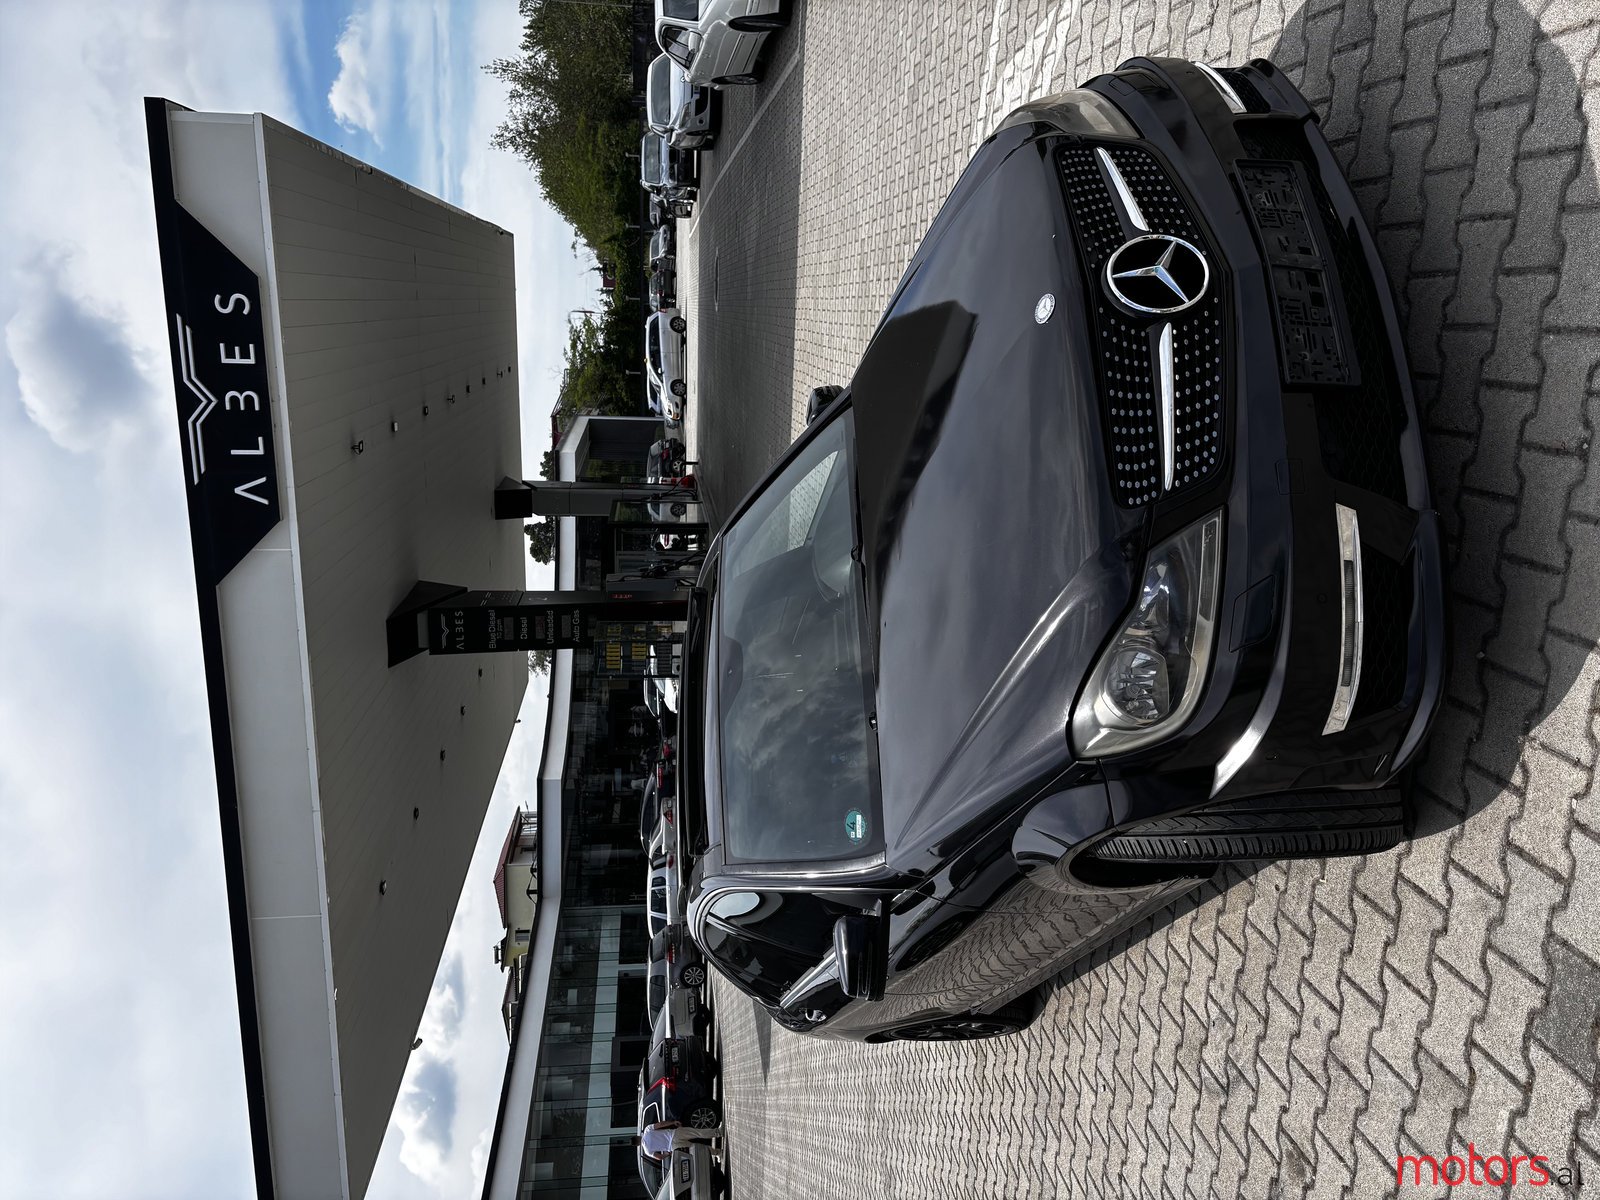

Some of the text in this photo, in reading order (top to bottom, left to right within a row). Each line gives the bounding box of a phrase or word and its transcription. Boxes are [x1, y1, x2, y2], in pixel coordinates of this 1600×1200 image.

[213, 292, 270, 506] ALBES
[454, 610, 465, 650] ALBES
[520, 617, 528, 640] Diesel
[546, 610, 554, 644] Unleaded
[572, 609, 580, 625] Gas
[847, 821, 856, 830] 4
